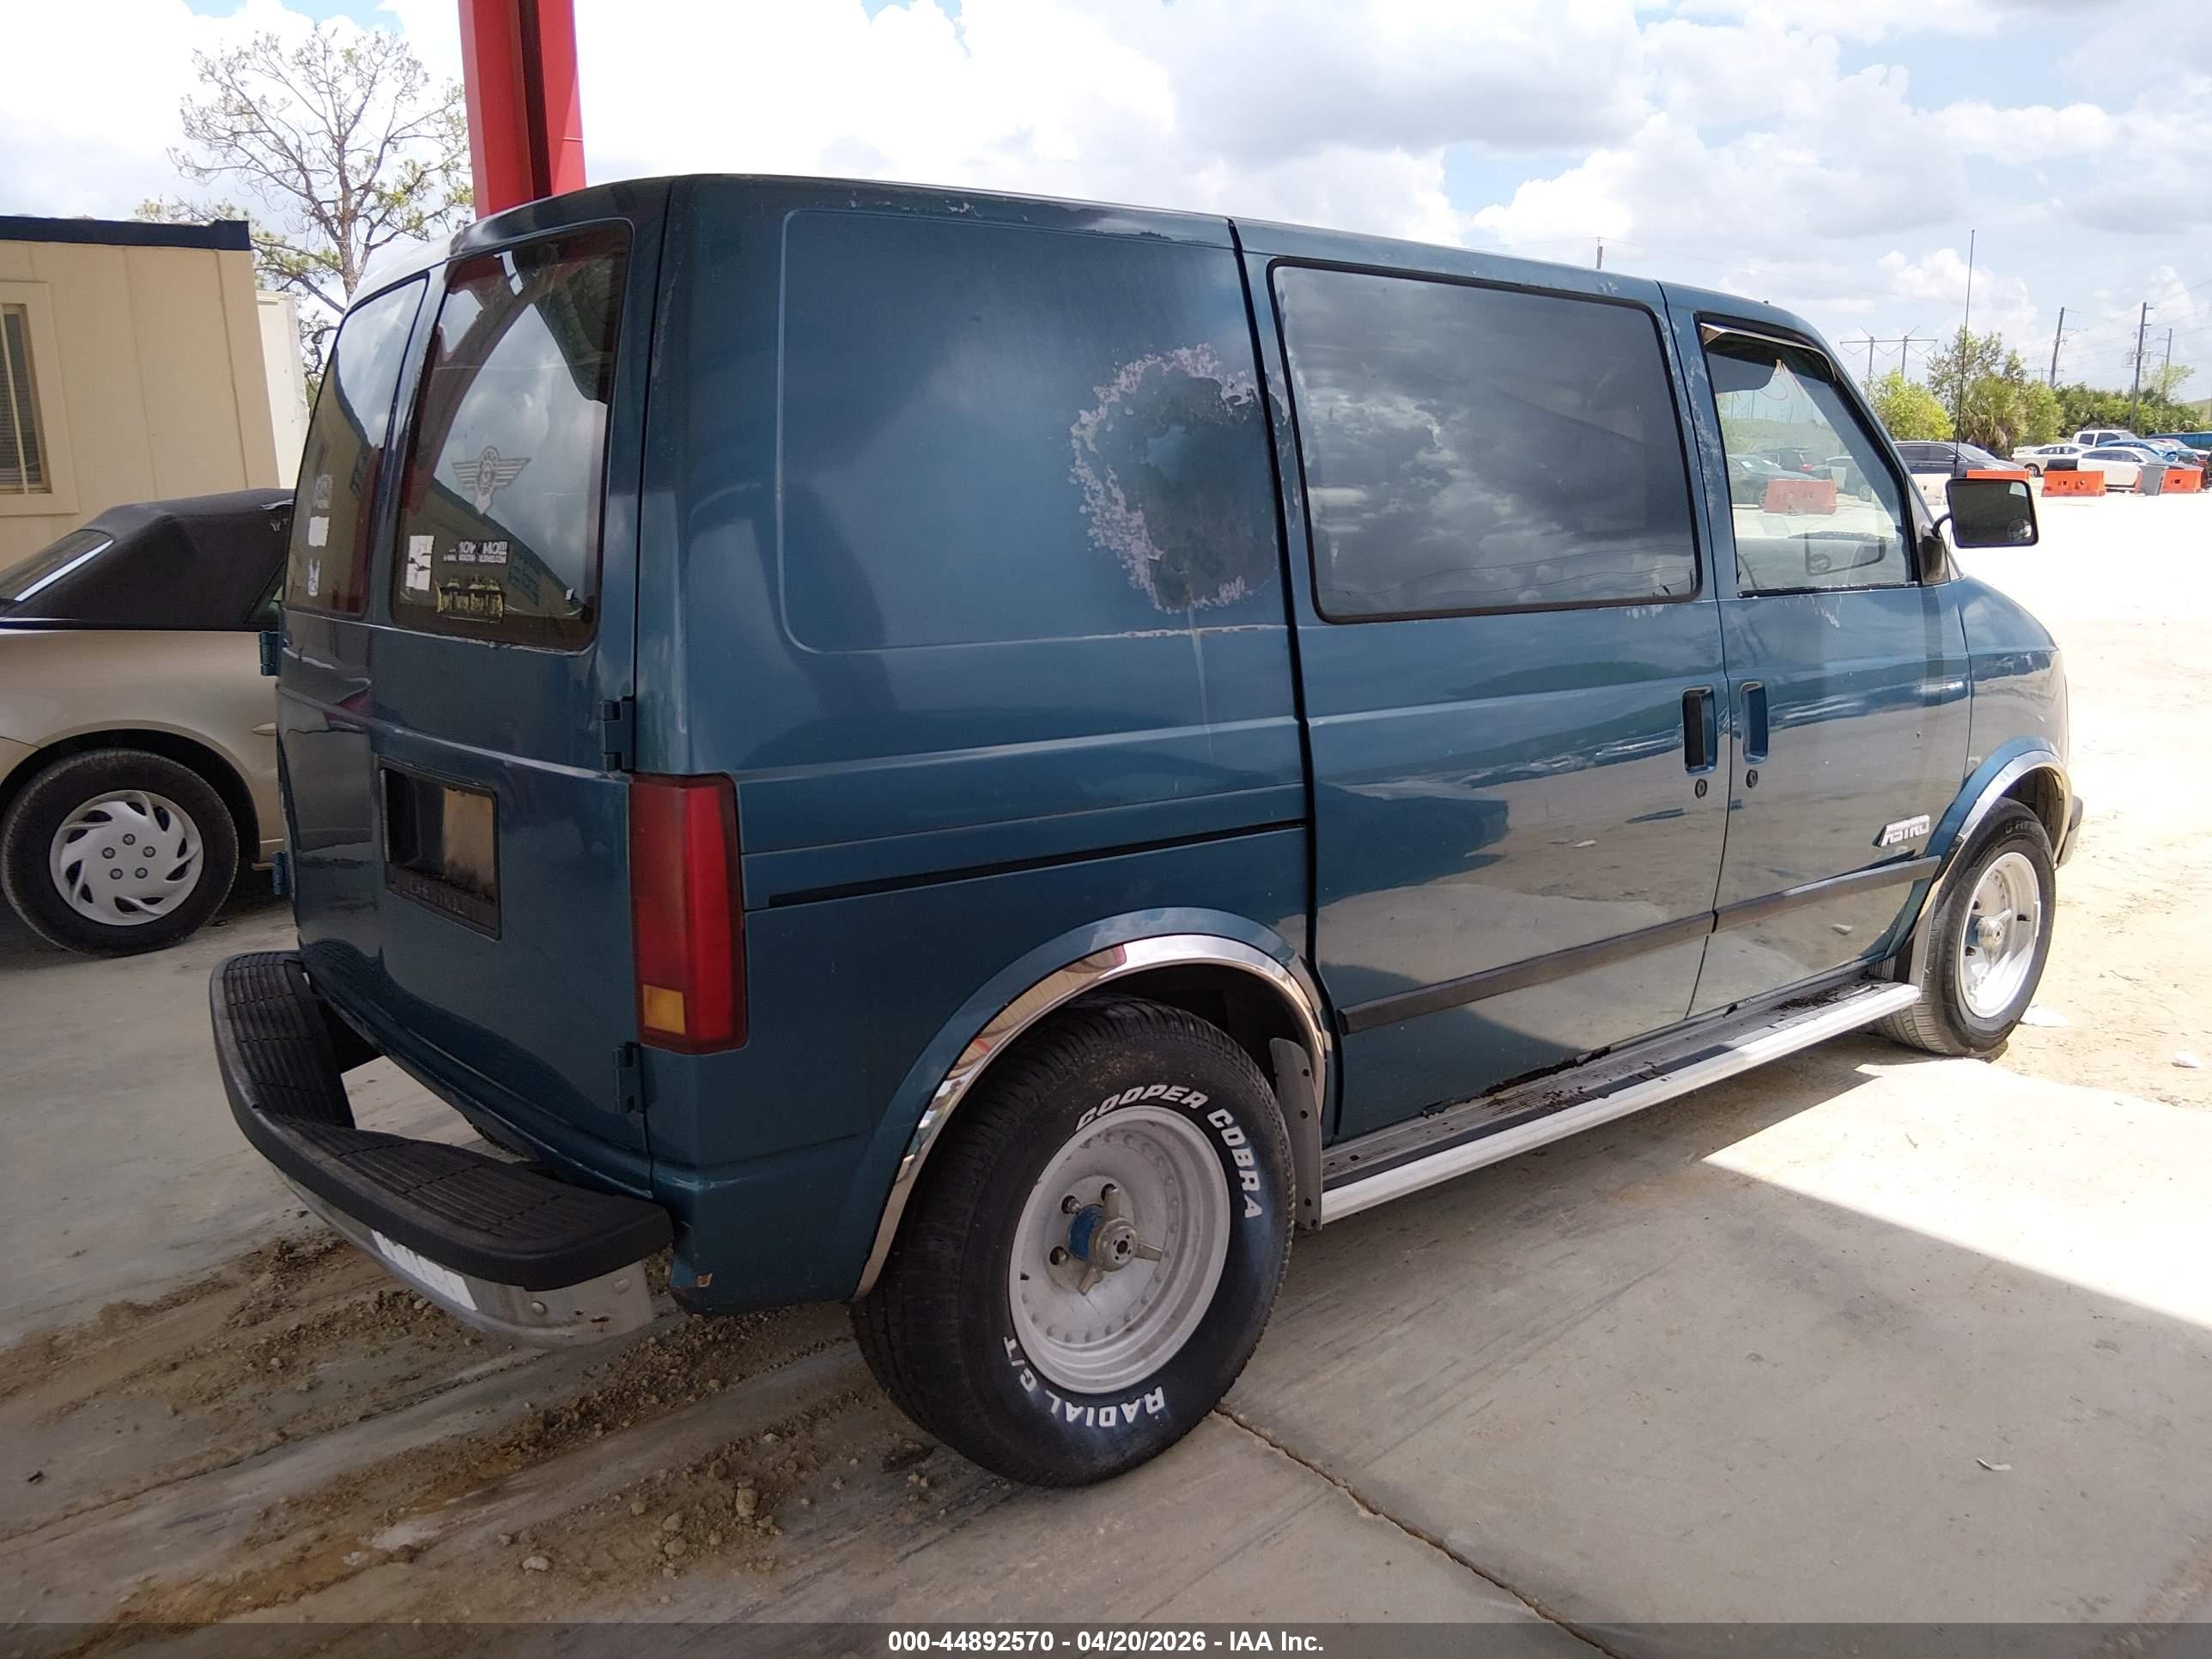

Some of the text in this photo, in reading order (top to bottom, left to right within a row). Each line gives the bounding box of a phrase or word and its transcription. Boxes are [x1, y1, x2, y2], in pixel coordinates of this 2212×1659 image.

[1881, 814, 1930, 847] ASTRO
[1075, 1084, 1263, 1218] COOPER COBRA
[1045, 1385, 1166, 1428] RADIAL
